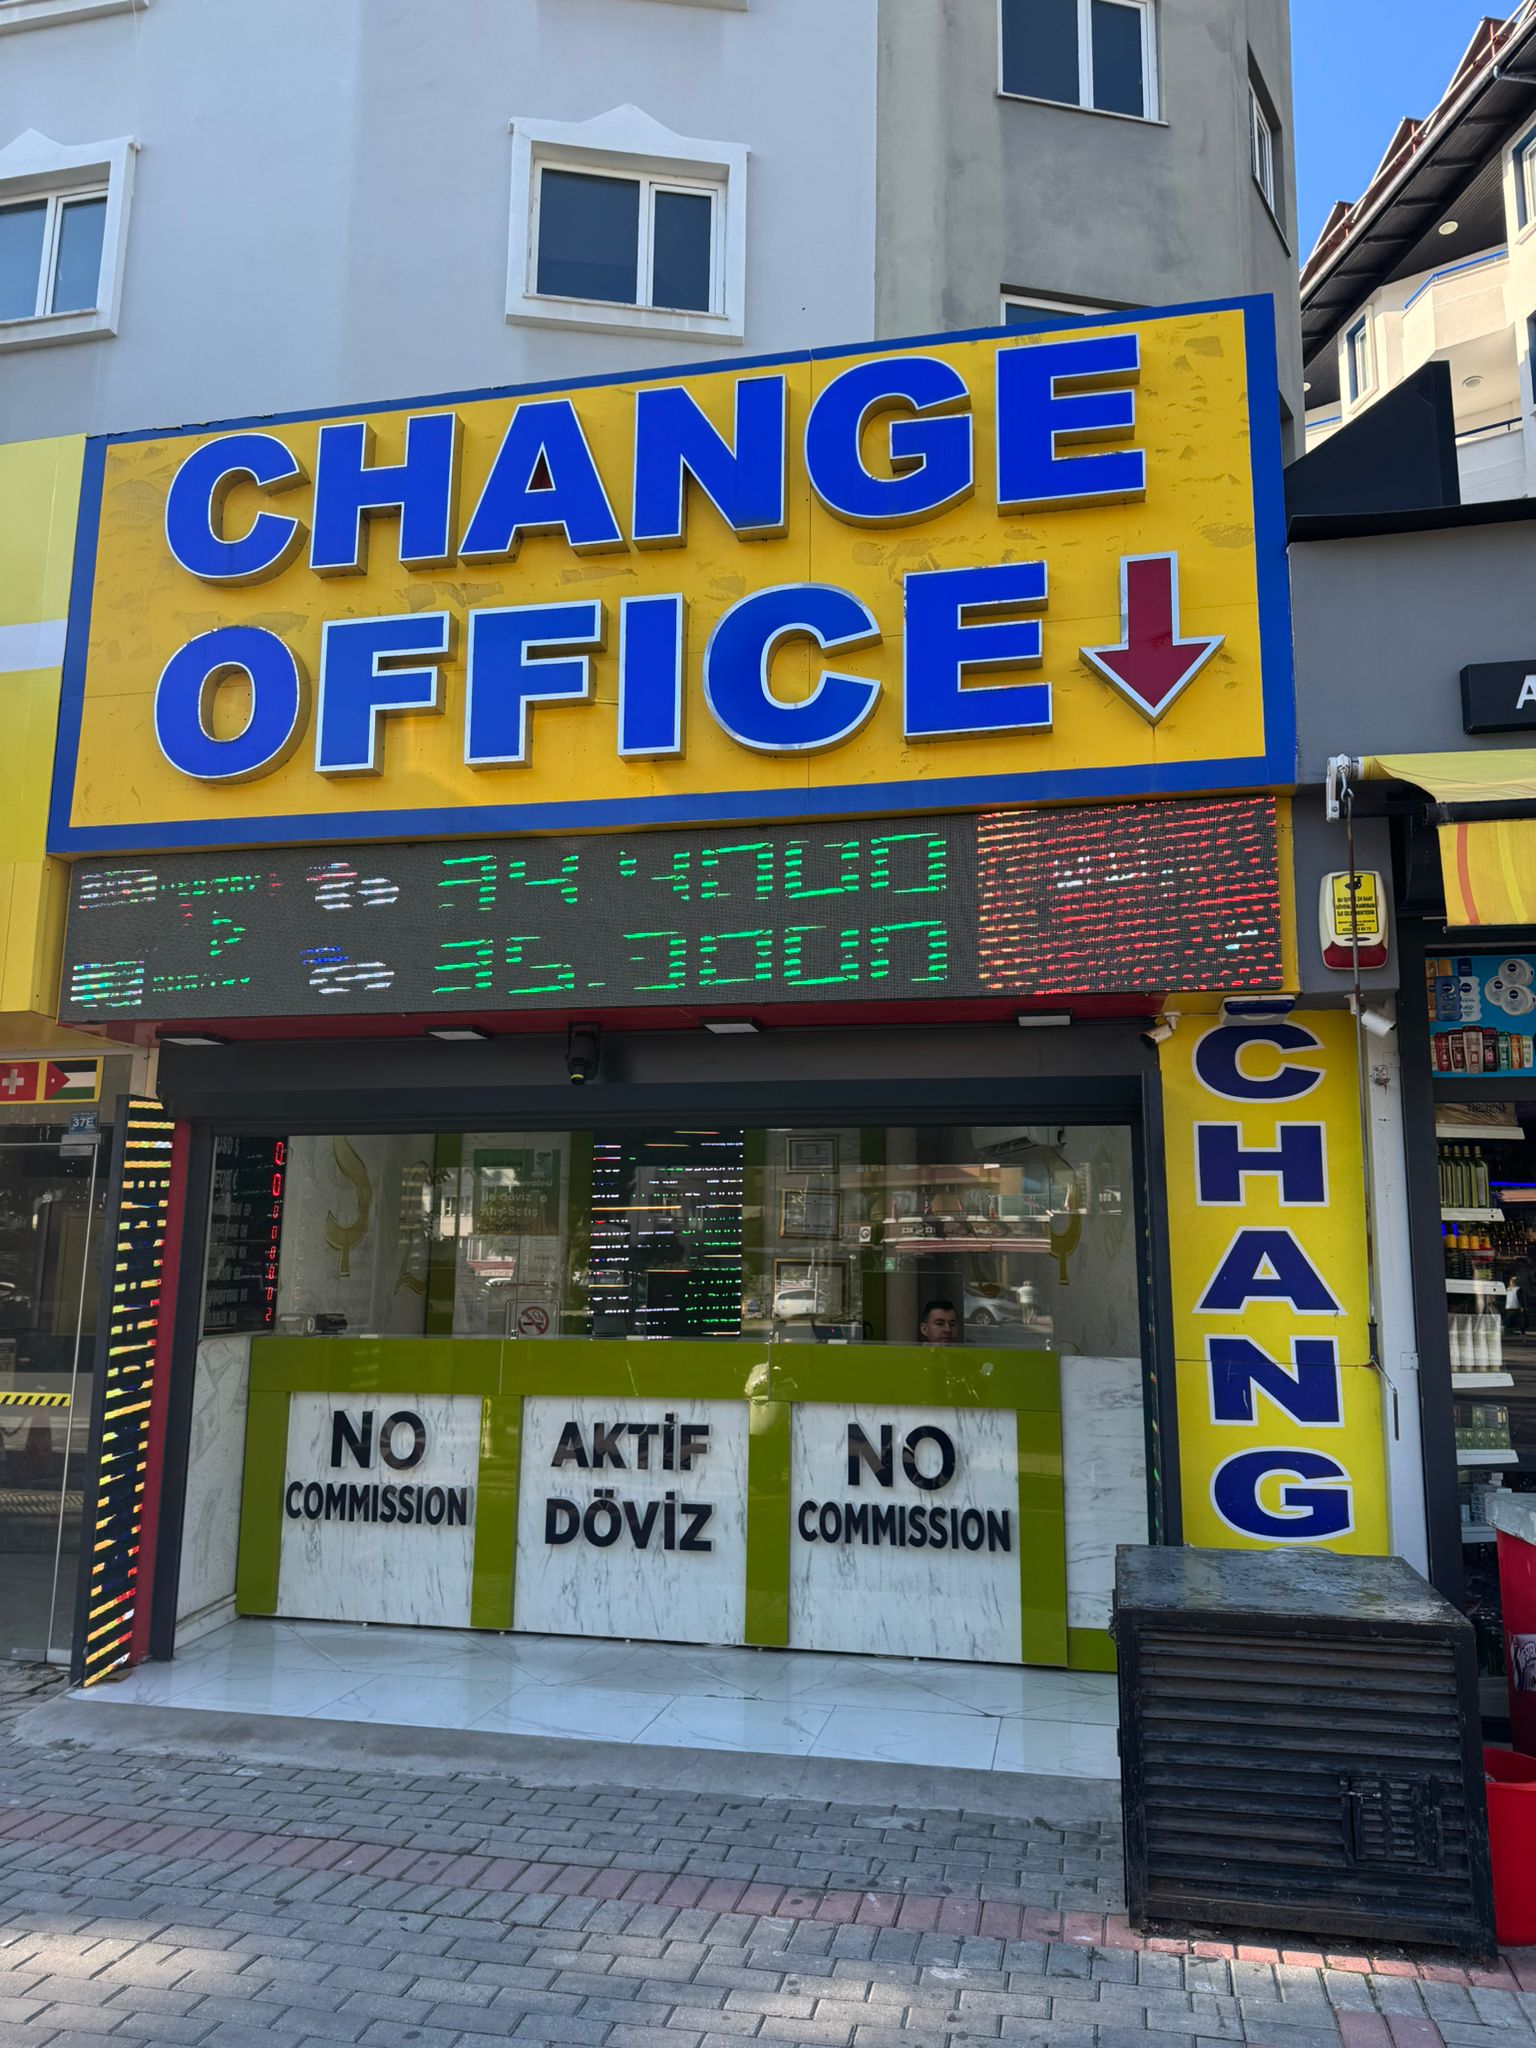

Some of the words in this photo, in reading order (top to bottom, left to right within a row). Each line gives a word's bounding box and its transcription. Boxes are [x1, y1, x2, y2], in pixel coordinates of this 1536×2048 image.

[164, 333, 1147, 583] CHANGE
[154, 560, 1054, 783] OFFICE
[72, 1117, 94, 1127] 37E
[330, 1410, 428, 1470] NO
[550, 1412, 711, 1471] AKTİF
[847, 1423, 956, 1490] NO
[285, 1481, 468, 1526] COMMISSION
[545, 1489, 714, 1552] DÖVİZ
[798, 1500, 1011, 1552] COMMISSION
